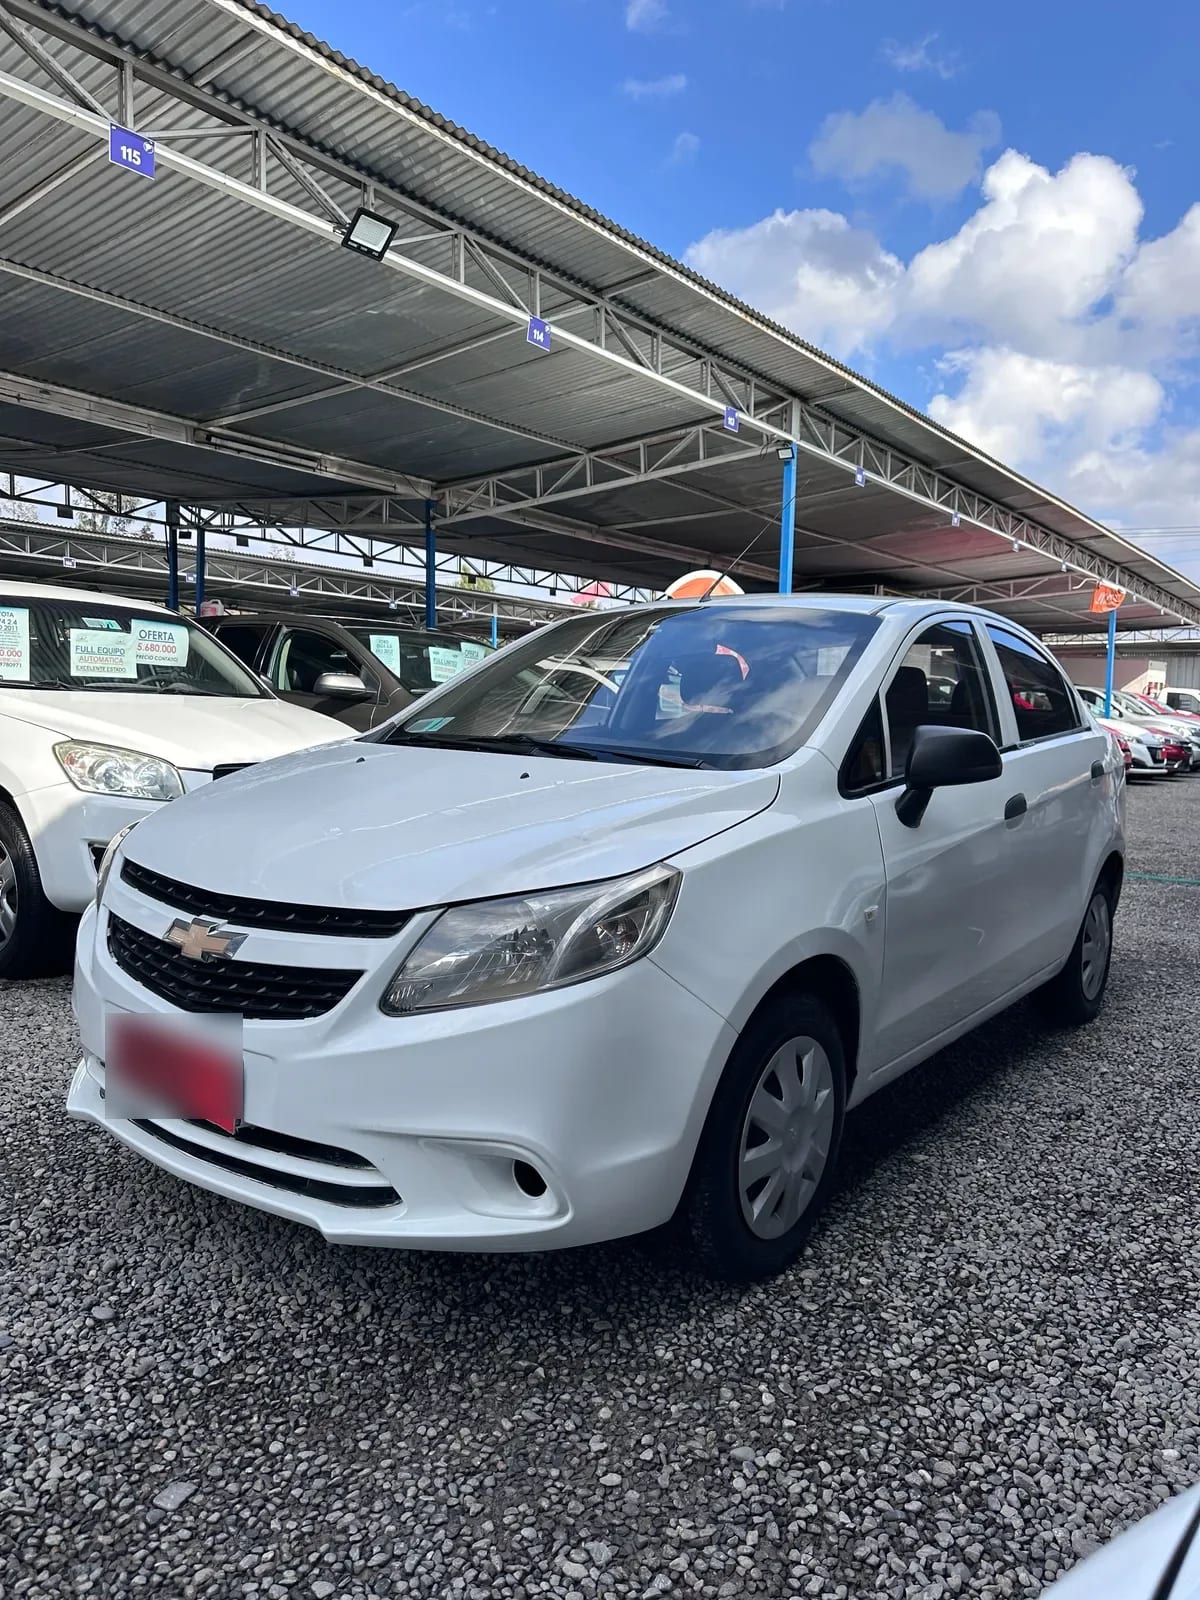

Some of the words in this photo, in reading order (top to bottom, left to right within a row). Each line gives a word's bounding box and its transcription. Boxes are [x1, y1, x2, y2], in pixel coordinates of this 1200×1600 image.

[120, 145, 141, 165] 115
[533, 329, 544, 342] 114
[138, 629, 175, 642] OFERTA
[75, 645, 94, 653] FULL
[97, 646, 126, 656] EQUIPO
[79, 655, 124, 664] AUTOMATICA
[75, 664, 107, 673] EXCELENTE
